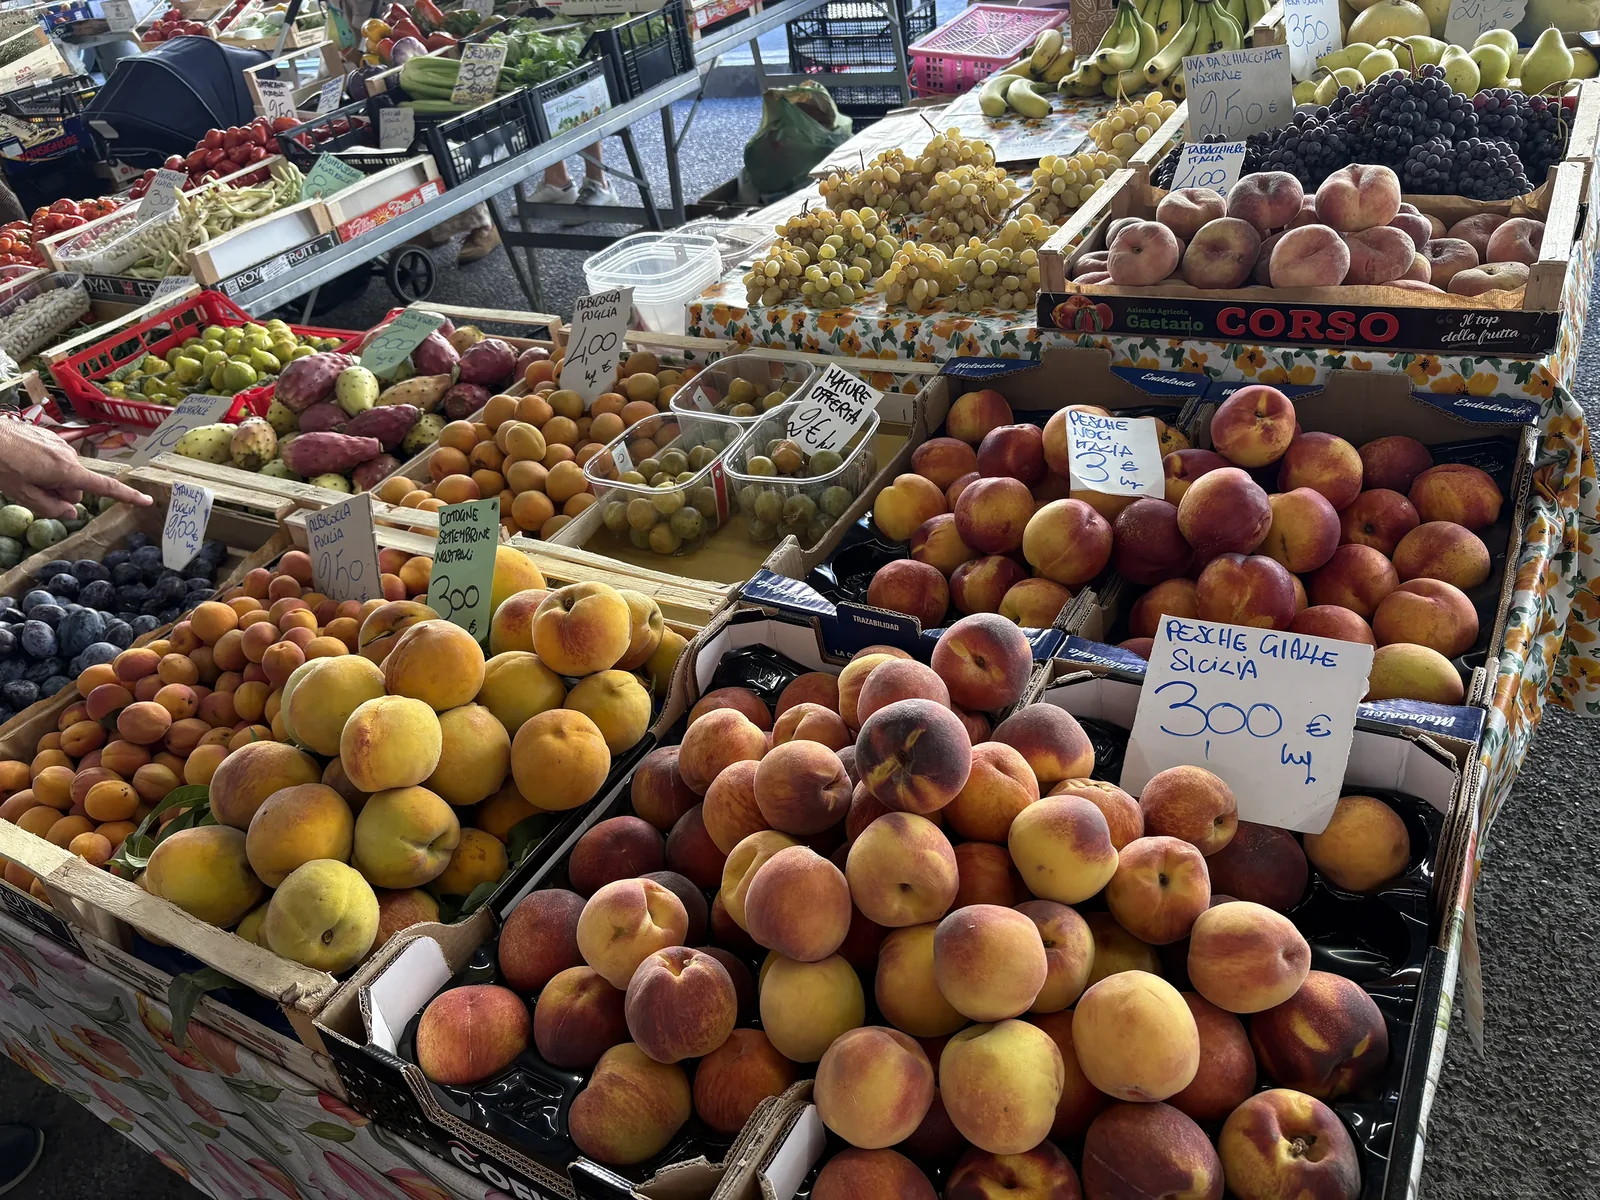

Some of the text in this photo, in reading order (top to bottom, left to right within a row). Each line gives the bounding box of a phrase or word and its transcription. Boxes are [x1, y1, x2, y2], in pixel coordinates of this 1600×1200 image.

[1186, 56, 1205, 72] UVA
[1191, 70, 1243, 88] NOSTRALE
[576, 291, 621, 311] ALBICOCCA
[1126, 306, 1189, 316] Azienda Agricola
[581, 306, 618, 323] PUGLIA
[1126, 315, 1204, 332] Gaetano
[1216, 306, 1400, 343] CORSO
[1459, 313, 1501, 328] Il top
[1441, 328, 1521, 345] della frutta
[824, 368, 872, 406] MATURE
[811, 386, 863, 425] OFFERTA
[1068, 410, 1128, 431] PESCHE
[1075, 440, 1133, 458] ITALIA
[1075, 452, 1139, 482] 3 €
[172, 483, 205, 506] STANLEY
[171, 499, 197, 516] PUGLIA
[309, 502, 352, 533] ALBICOCCA
[440, 506, 479, 526] COTOGNE
[313, 527, 345, 551] PUGLIA
[852, 614, 900, 631] TRAZABILIDAD
[834, 649, 845, 657] LA
[1166, 620, 1339, 668] PESCHE GIALLE
[1169, 648, 1258, 680] SICILIA
[1305, 714, 1332, 738] €
